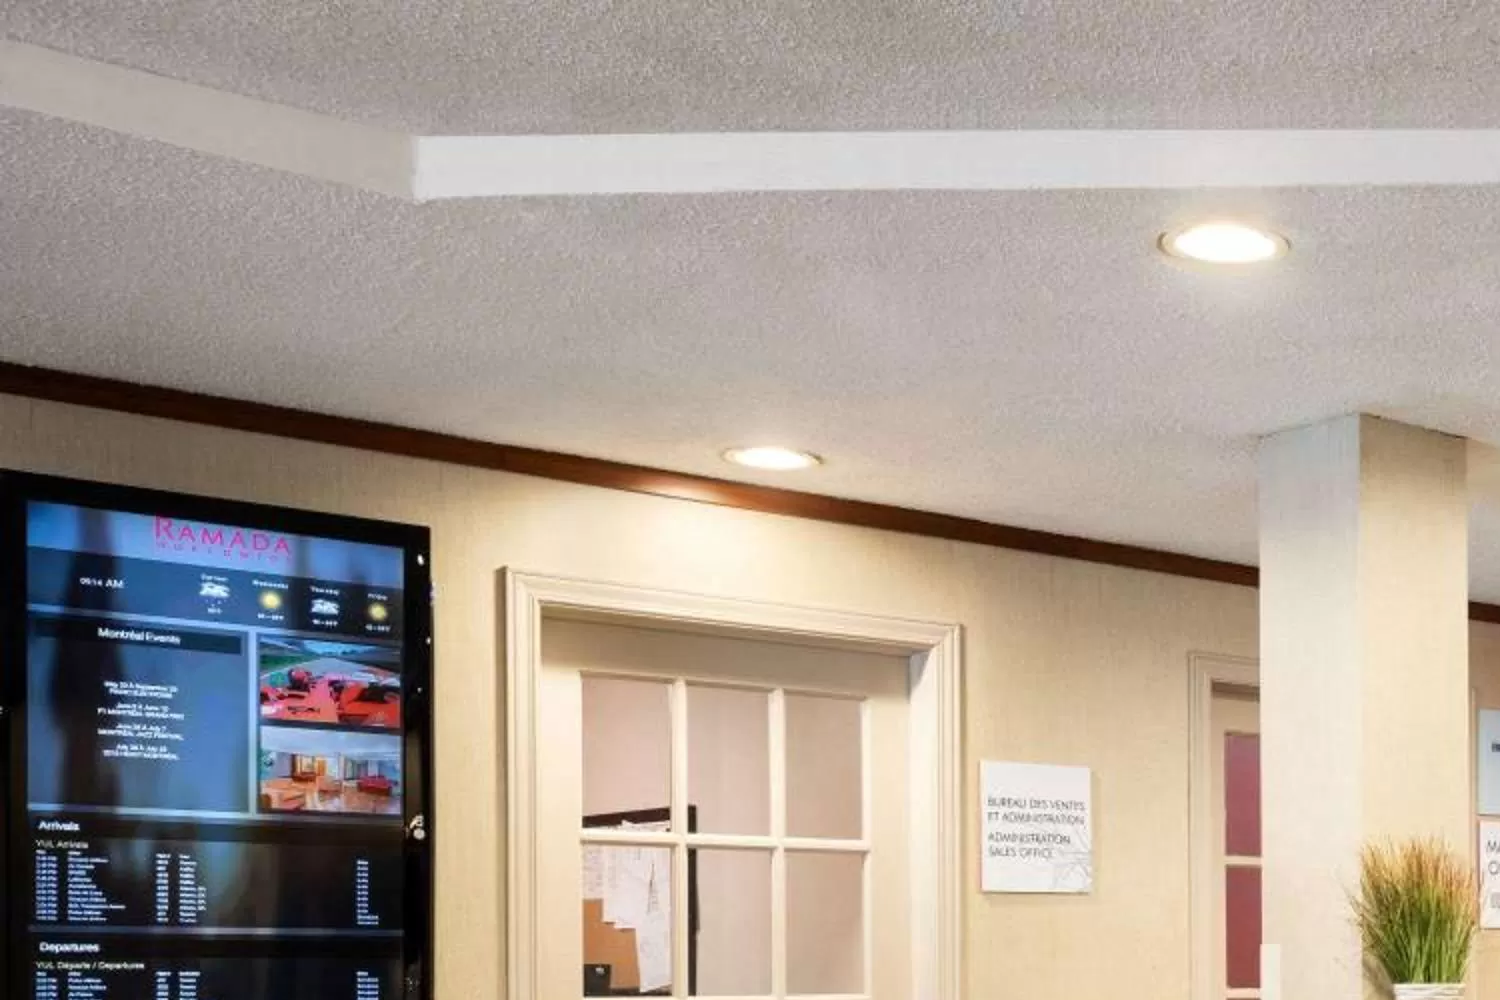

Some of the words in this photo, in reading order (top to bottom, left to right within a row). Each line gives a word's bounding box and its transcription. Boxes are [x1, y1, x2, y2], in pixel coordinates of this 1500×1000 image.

[155, 514, 290, 554] RAMADA
[105, 577, 126, 589] AM
[146, 630, 181, 645] Events
[987, 797, 1027, 809] BUREAU
[1029, 798, 1049, 810] DES
[1050, 799, 1086, 812] VENTES
[38, 821, 81, 831] Arrivals
[987, 811, 999, 822] ET
[1001, 811, 1085, 826] ADMINISTRATION
[988, 831, 1071, 845] ADMINISTRATION
[989, 845, 1017, 858] SALES
[1019, 847, 1054, 860] OFFICE
[39, 941, 100, 953] Departures
